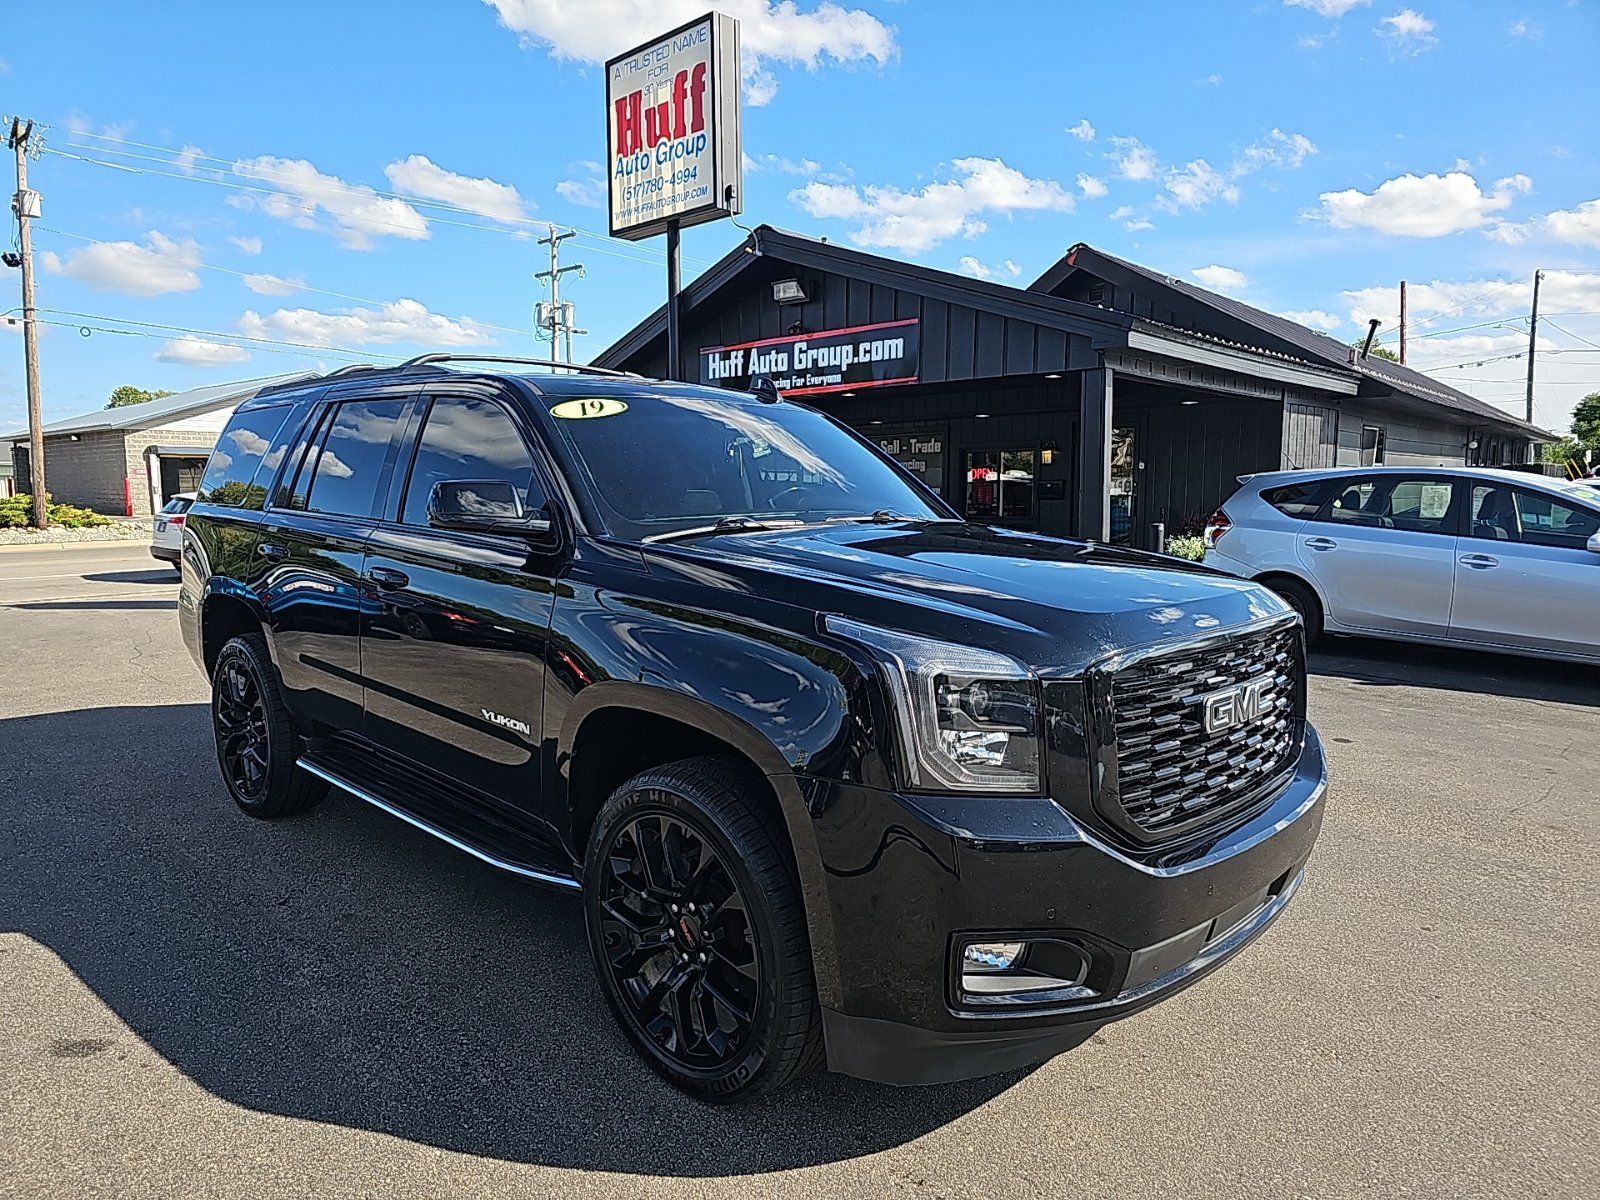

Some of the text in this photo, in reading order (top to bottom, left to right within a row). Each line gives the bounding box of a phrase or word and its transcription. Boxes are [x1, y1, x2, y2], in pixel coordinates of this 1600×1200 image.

[614, 26, 707, 81] A TRUSTED NAME
[648, 62, 669, 79] FOR
[615, 62, 706, 158] Huff
[615, 133, 706, 179] Auto Group
[614, 185, 708, 219] WWW.HUFFAUTOGROUP.COM
[622, 165, 698, 203] (517)780-4994
[708, 337, 904, 379] Huff Auto Group.com
[792, 375, 805, 387] For
[806, 373, 842, 386] Everyone
[580, 400, 604, 416] 19
[880, 439, 900, 454] Sell
[910, 438, 941, 453] Trade
[1202, 672, 1276, 734] GMC
[481, 708, 530, 735] YUKON
